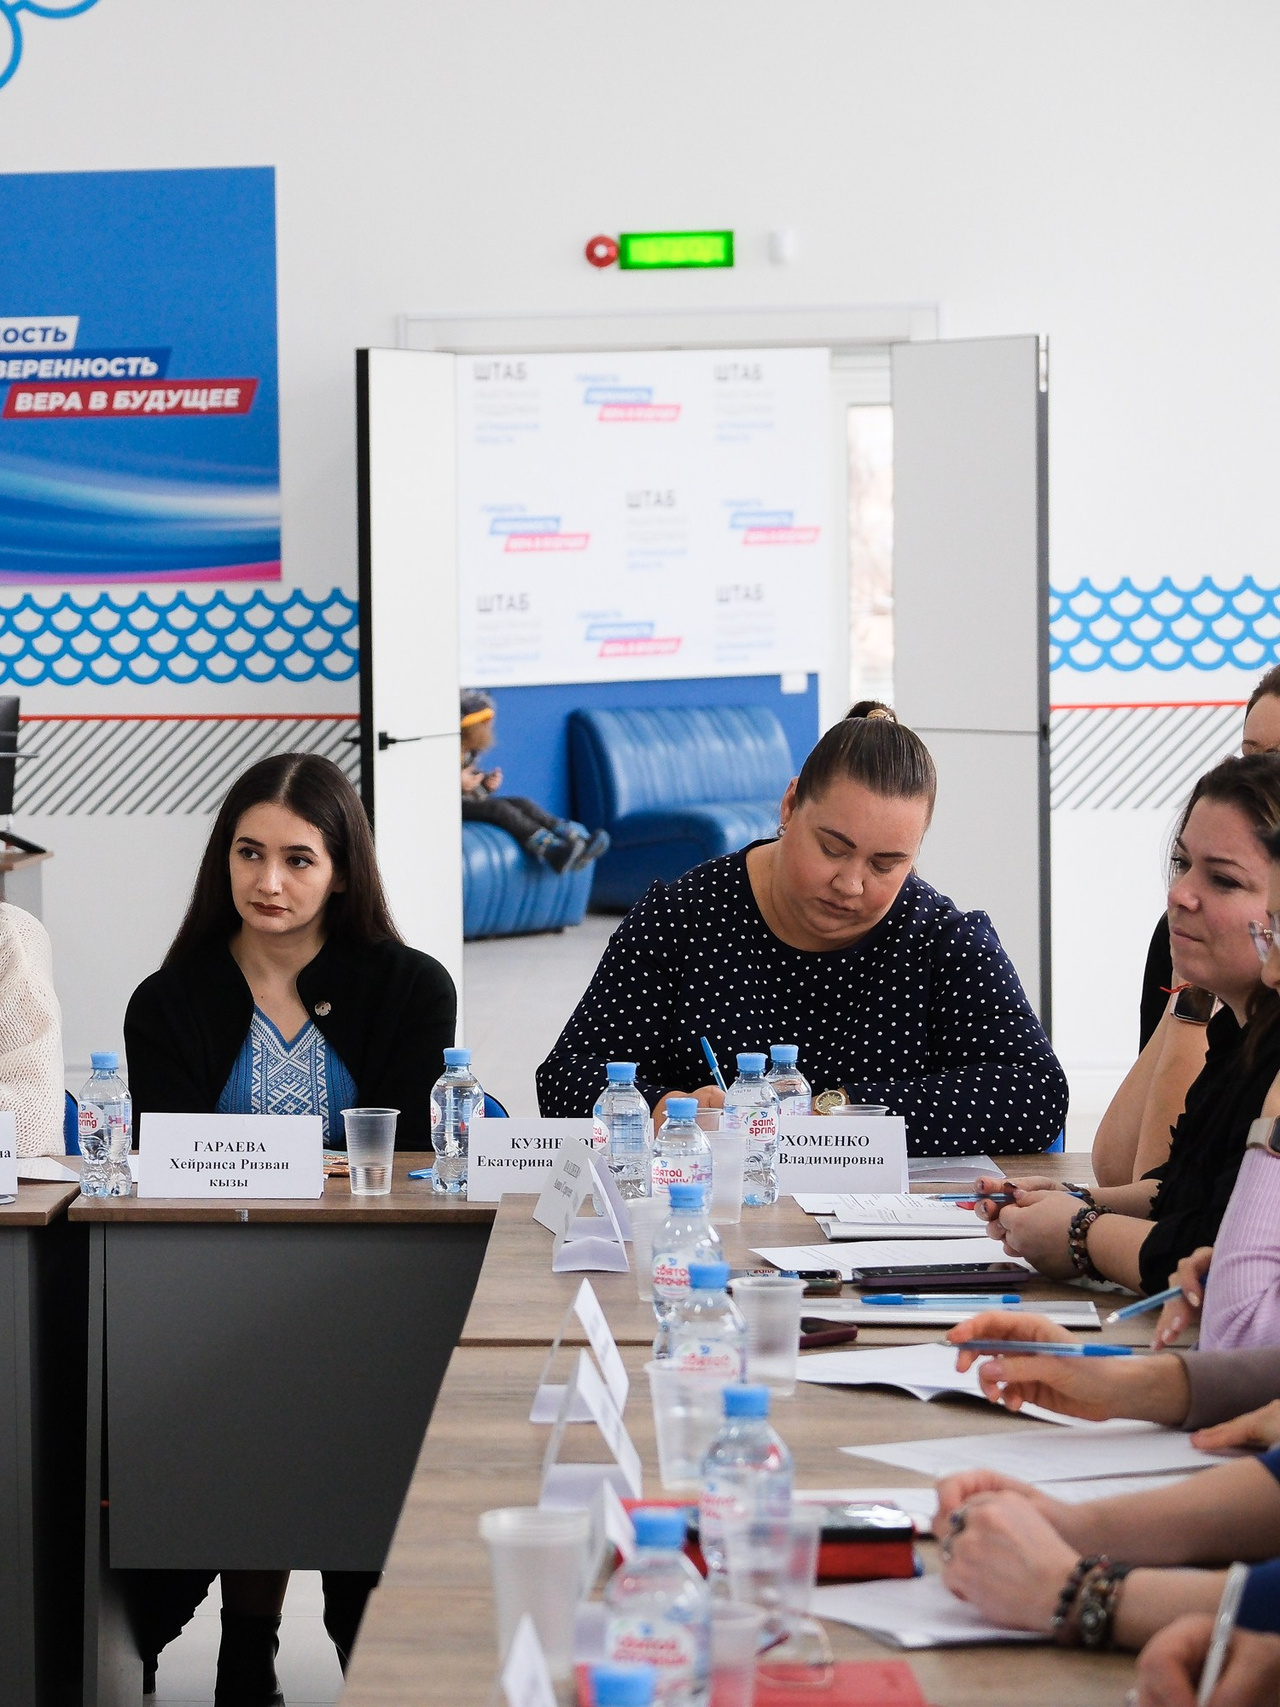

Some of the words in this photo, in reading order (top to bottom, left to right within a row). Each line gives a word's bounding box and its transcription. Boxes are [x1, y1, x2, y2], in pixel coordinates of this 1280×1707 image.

[474, 362, 528, 382] ШТАБ
[715, 363, 762, 383] ШТАБ
[14, 391, 83, 412] ВЕРА
[87, 390, 108, 411] В
[112, 387, 241, 412] БУДУЩЕЕ
[626, 489, 676, 509] ШТАБ
[717, 584, 764, 603] ШТАБ
[476, 592, 530, 614] ШТАБ
[752, 1117, 774, 1126] saint
[749, 1126, 776, 1137] spring
[194, 1141, 266, 1152] ГАРАЕВА
[169, 1158, 236, 1172] Хейранса
[241, 1158, 290, 1170] Ризван
[477, 1155, 553, 1170] Екатерина
[779, 1152, 884, 1167] Владимировна
[209, 1178, 249, 1188] кызы
